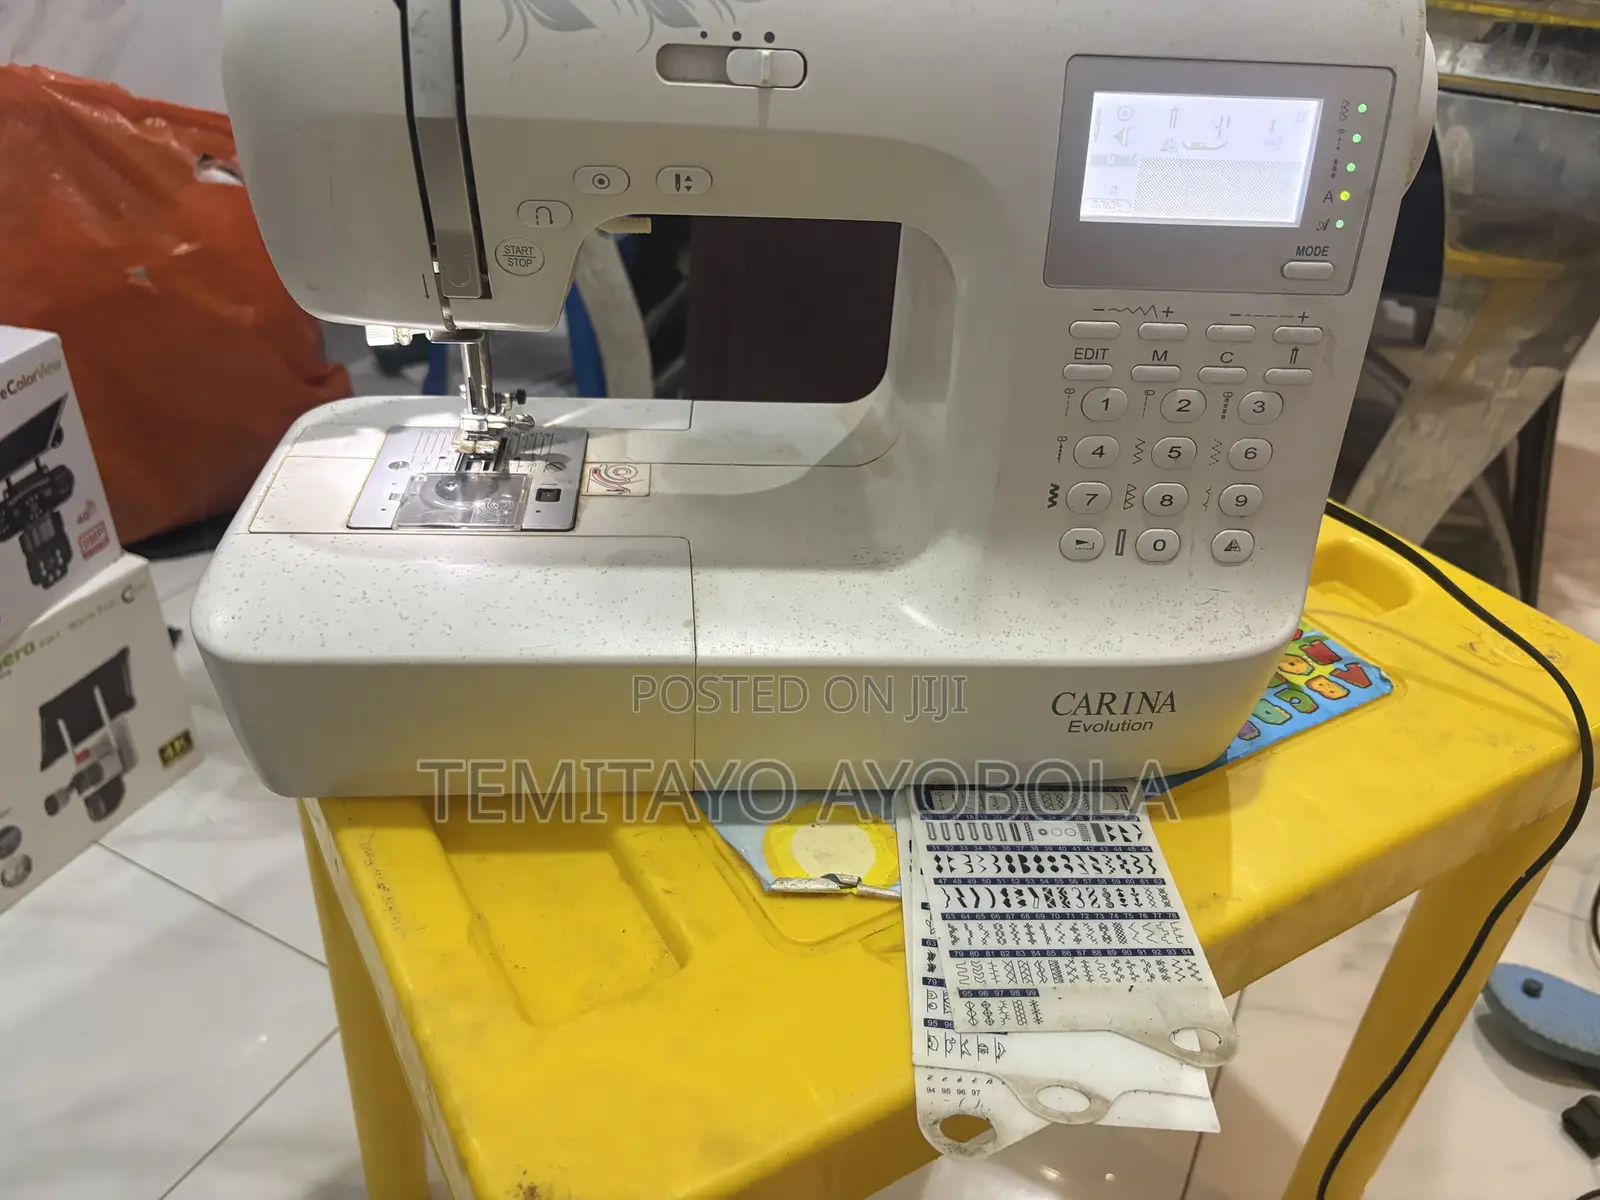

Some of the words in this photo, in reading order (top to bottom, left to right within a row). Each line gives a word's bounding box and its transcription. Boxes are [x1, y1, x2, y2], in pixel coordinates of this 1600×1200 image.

[1322, 190, 1333, 204] A
[504, 244, 534, 256] START
[1296, 246, 1328, 256] MODE
[507, 258, 532, 268] STOP
[1074, 348, 1109, 360] EDIT
[1152, 350, 1168, 362] M
[1220, 352, 1234, 364] C
[1100, 398, 1110, 411] 1
[1176, 399, 1192, 412] 2
[1252, 400, 1266, 414] 3
[1091, 445, 1105, 458] 4
[1168, 446, 1182, 459] 5
[1244, 447, 1258, 460] 6
[1085, 493, 1098, 506] 7
[1160, 494, 1174, 507] 8
[1235, 494, 1248, 507] 9
[1304, 675, 1350, 700] B
[1051, 690, 1178, 716] CARINA
[1274, 688, 1319, 714] C
[1067, 719, 1154, 734] Evolution
